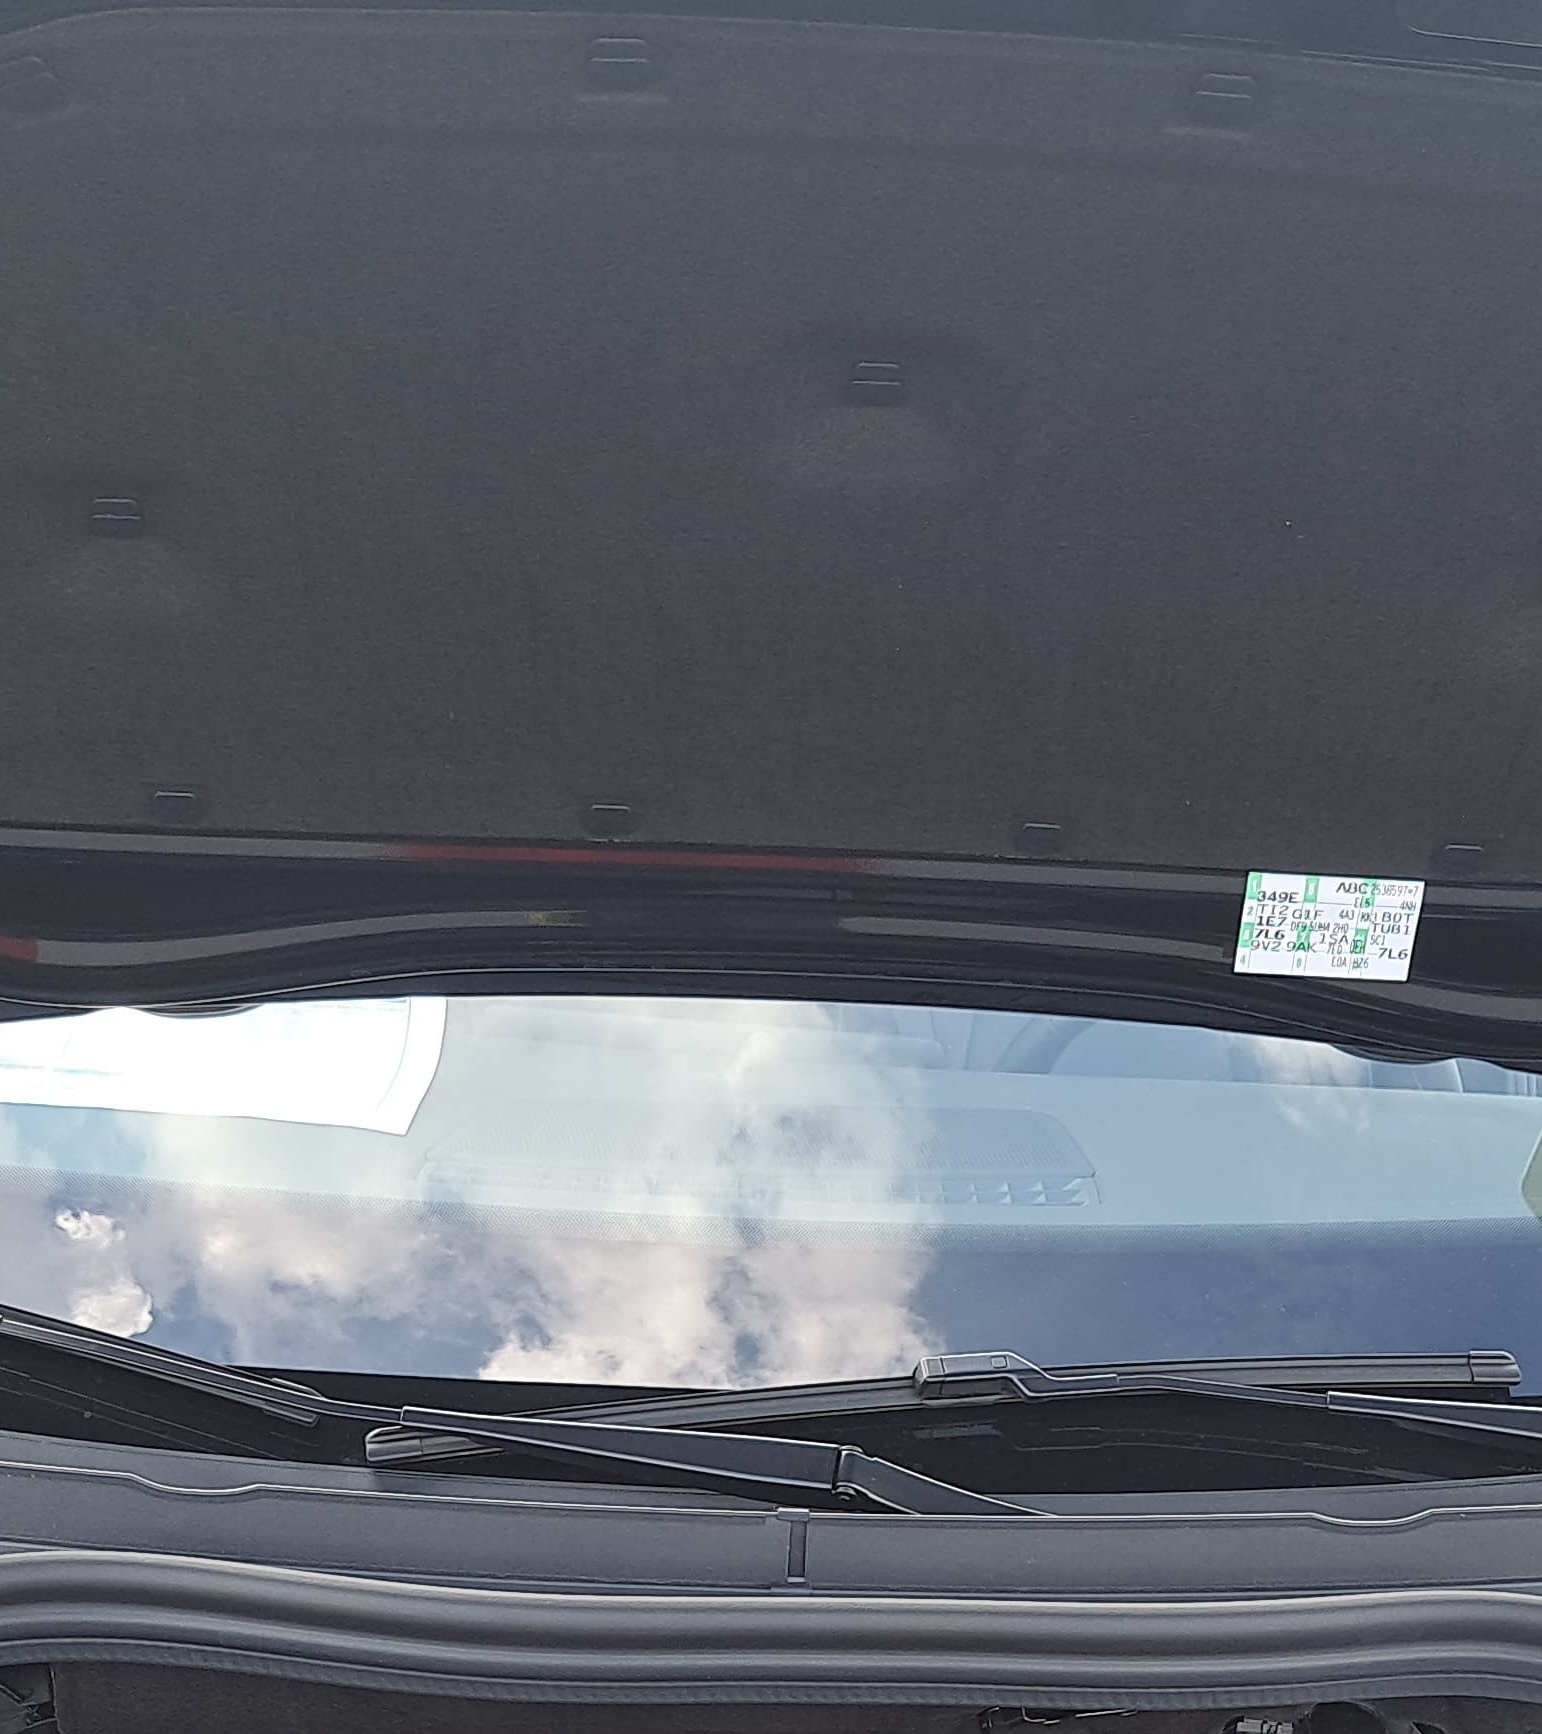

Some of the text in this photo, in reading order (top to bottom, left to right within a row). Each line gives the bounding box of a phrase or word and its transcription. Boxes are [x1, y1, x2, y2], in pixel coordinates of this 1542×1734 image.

[1336, 882, 1369, 895] ABC
[1257, 890, 1299, 904] 349E
[1256, 916, 1288, 928] 1E7
[1254, 927, 1286, 940] 7L6
[1250, 940, 1282, 953] 9V2
[1286, 940, 1317, 953] 9AK
[1378, 947, 1409, 960] 7L6
